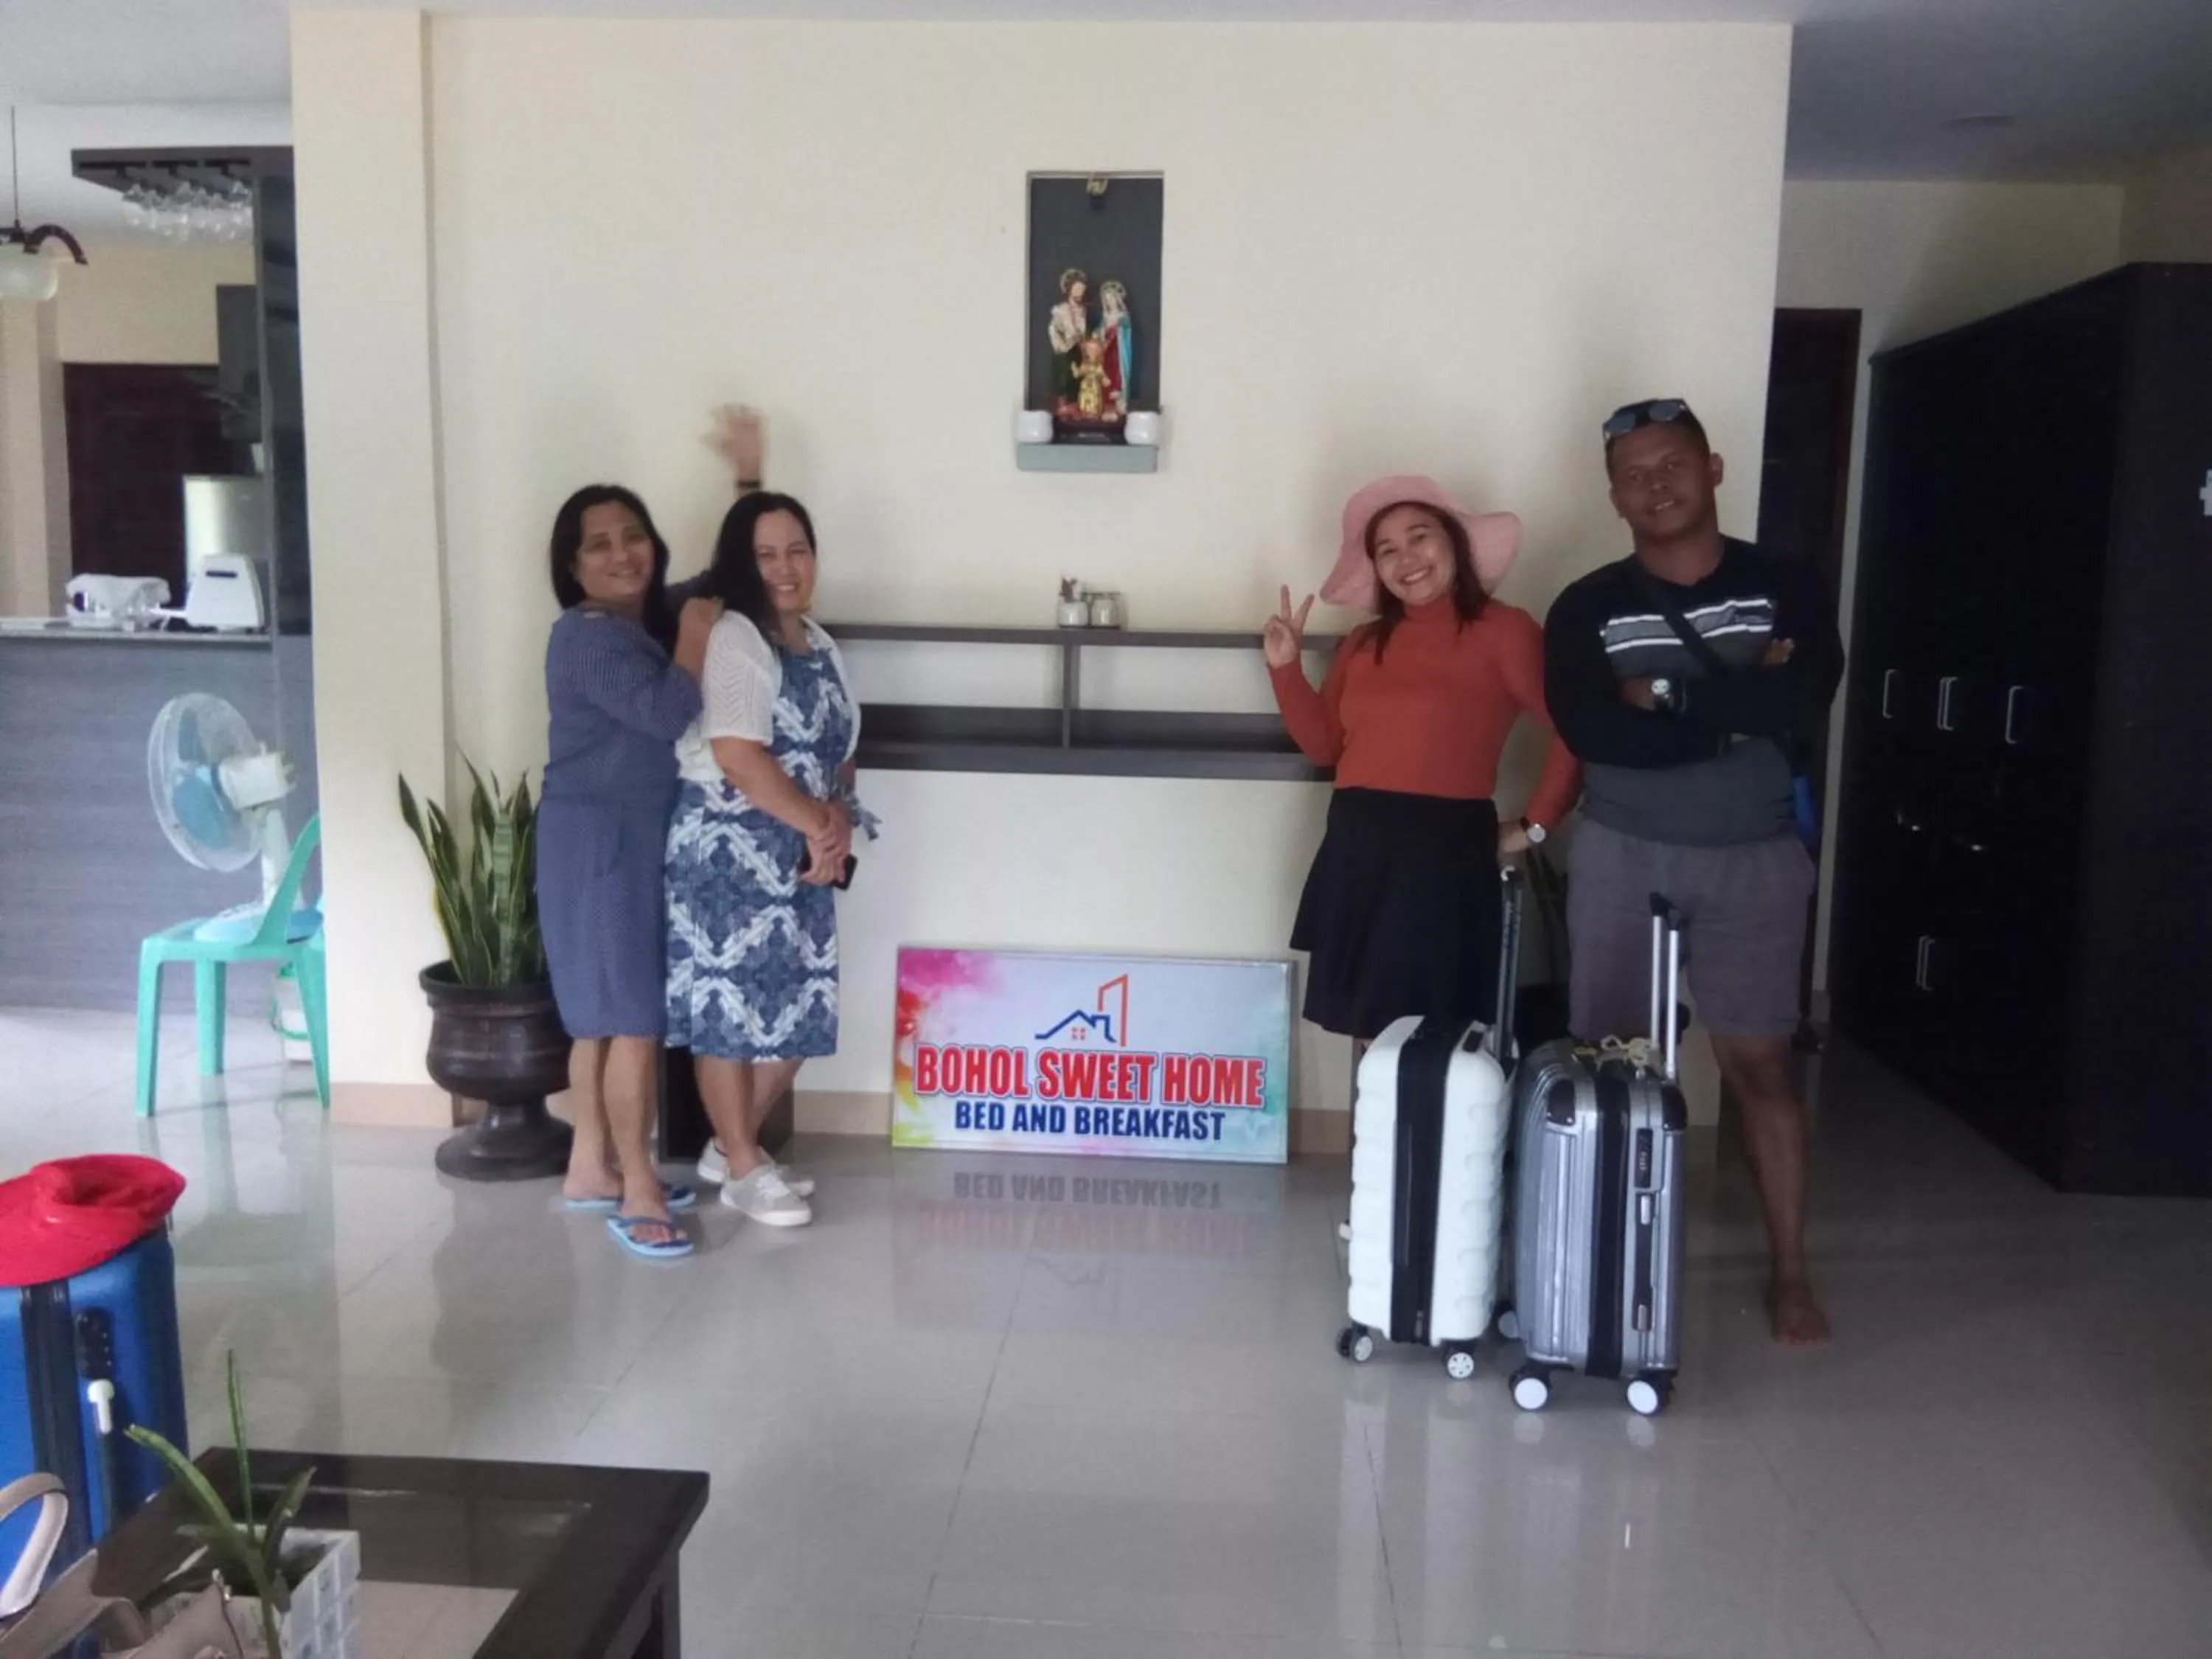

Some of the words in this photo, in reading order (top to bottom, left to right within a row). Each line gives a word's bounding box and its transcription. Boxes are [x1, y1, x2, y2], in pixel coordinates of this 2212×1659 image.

[916, 1044, 1030, 1097] BOHOL
[1037, 1048, 1157, 1102] SWEET
[1164, 1054, 1265, 1107] HOME
[955, 1100, 1005, 1130] BED
[1012, 1104, 1066, 1133] AND
[1074, 1106, 1226, 1141] BREAKFAST
